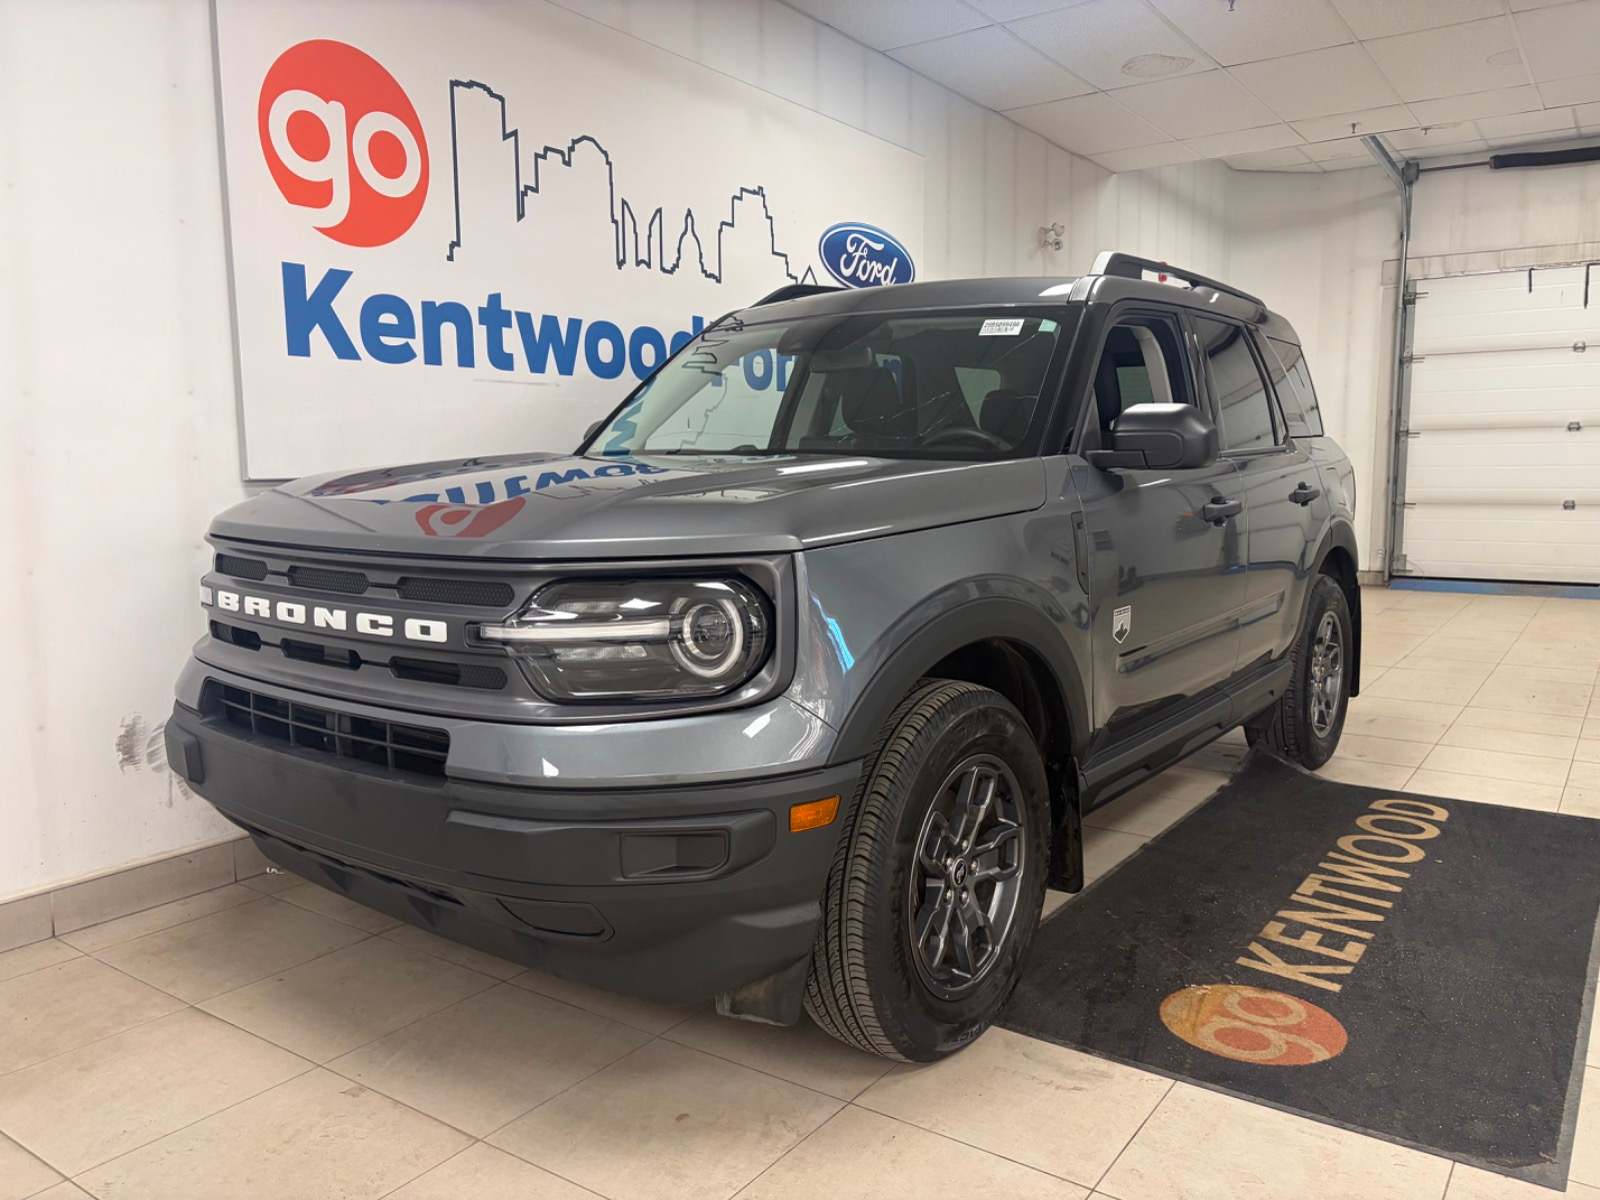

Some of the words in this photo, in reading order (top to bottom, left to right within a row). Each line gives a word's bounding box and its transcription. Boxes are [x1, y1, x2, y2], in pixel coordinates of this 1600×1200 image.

[269, 88, 422, 229] go
[840, 233, 898, 286] Ford
[217, 590, 448, 643] BRONCO
[1235, 799, 1450, 992] KENTWOOD
[1194, 991, 1331, 1063] go
